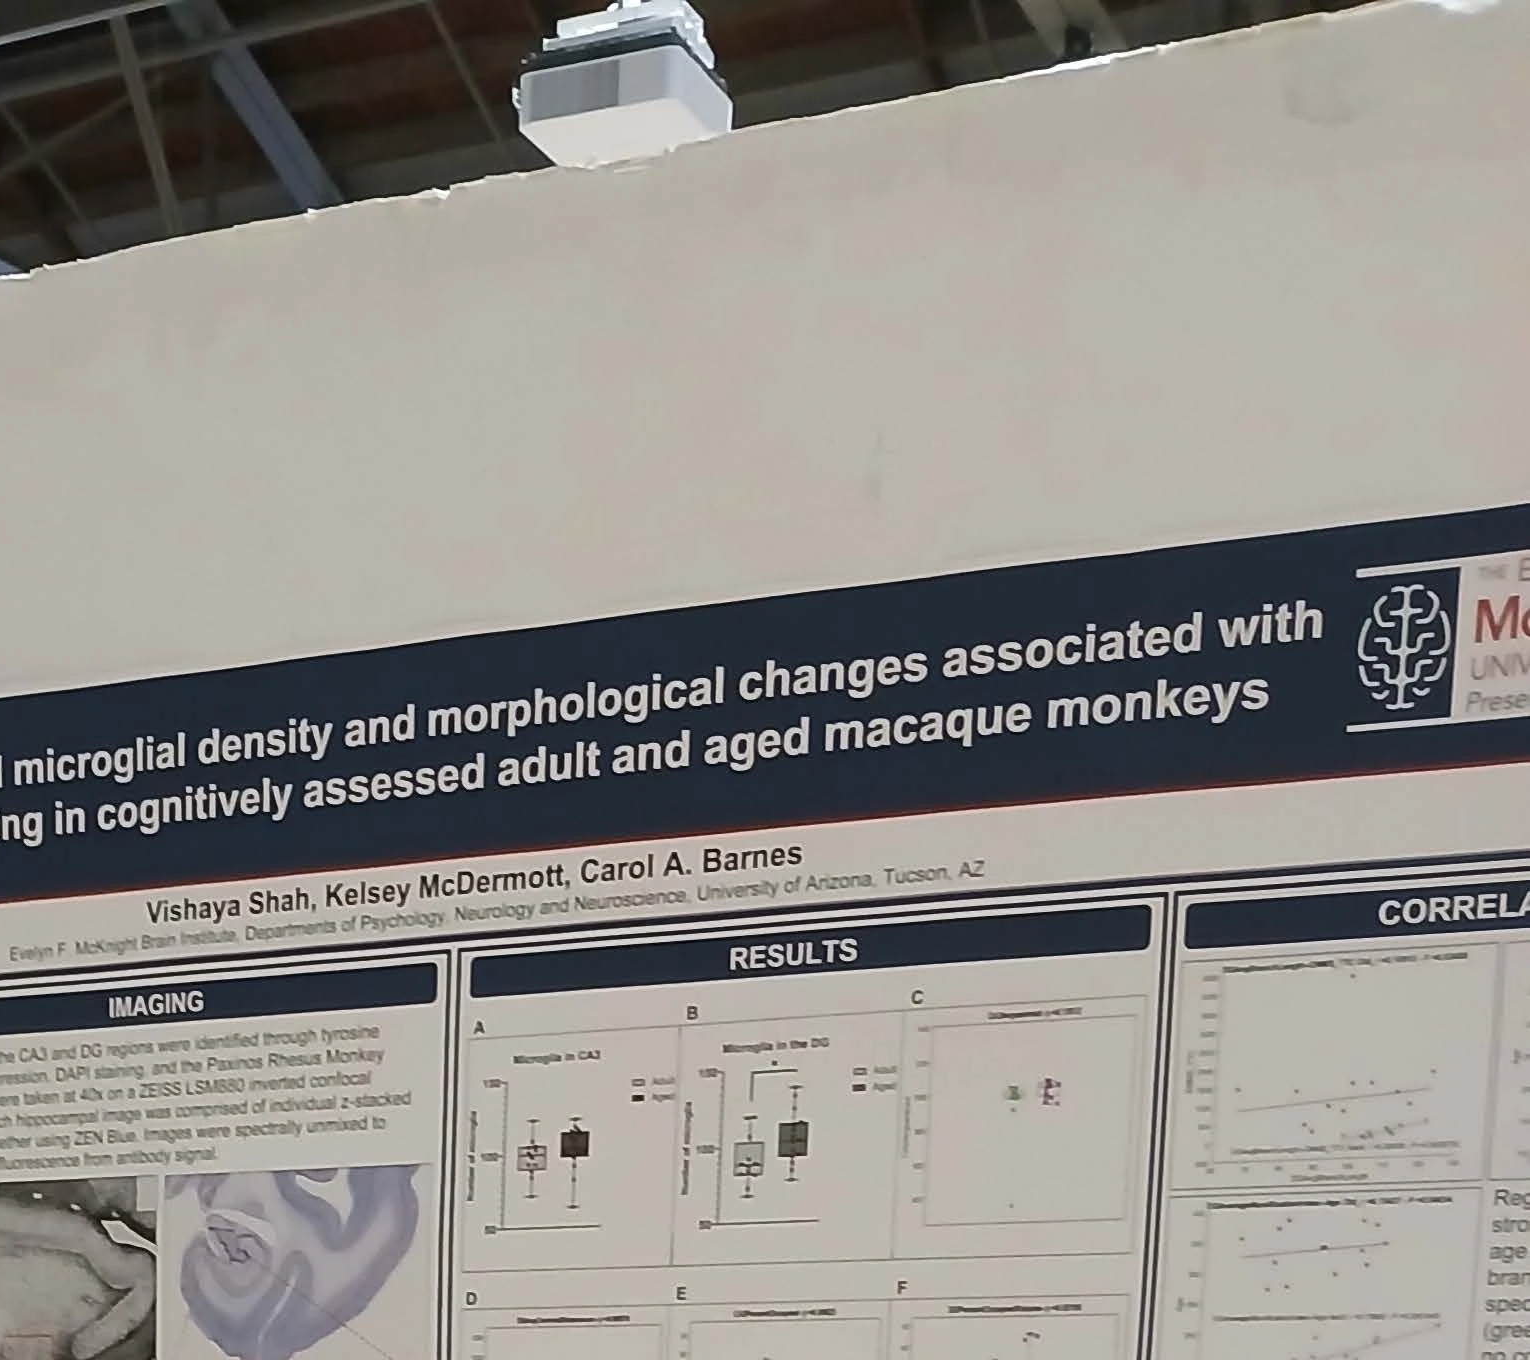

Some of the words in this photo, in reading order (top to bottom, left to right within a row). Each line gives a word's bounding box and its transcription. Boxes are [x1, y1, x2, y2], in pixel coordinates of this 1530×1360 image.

[14, 732, 186, 785] microglial
[198, 717, 333, 766] density
[344, 705, 415, 747] and
[428, 667, 724, 736] morphological
[739, 651, 928, 698] changes
[943, 612, 1202, 679] associated
[1219, 600, 1323, 648] with
[55, 801, 85, 836] in
[98, 778, 292, 835] cognitively
[303, 752, 485, 807] assessed
[498, 741, 600, 787] adult
[612, 730, 690, 774] and
[704, 717, 809, 771] aged
[825, 699, 1031, 752] macaque
[1047, 676, 1270, 729] monkeys
[147, 896, 240, 924] Vishaya
[249, 888, 317, 915] Shah,
[326, 880, 411, 907] Kelsey
[420, 864, 570, 900] McDermott,
[581, 853, 653, 884] Carol
[664, 852, 692, 876] A.
[703, 845, 802, 873] Barnes
[10, 945, 53, 962] Evelyn
[76, 936, 137, 957] McKnight
[141, 933, 176, 950] Brain
[245, 920, 336, 943] Departments
[341, 916, 357, 932] of
[455, 902, 535, 922] Neurology
[539, 897, 569, 914] and
[697, 879, 777, 904] University
[785, 877, 802, 894] of
[958, 861, 985, 878] AZ
[729, 938, 858, 971] RESULTS
[109, 990, 205, 1019] IMAGING
[911, 990, 924, 1004] C
[686, 1006, 698, 1020] B
[473, 1021, 485, 1034] A
[81, 1043, 102, 1058] DG
[676, 1287, 686, 1301] E
[898, 1281, 907, 1295] F
[466, 1293, 477, 1306] D
